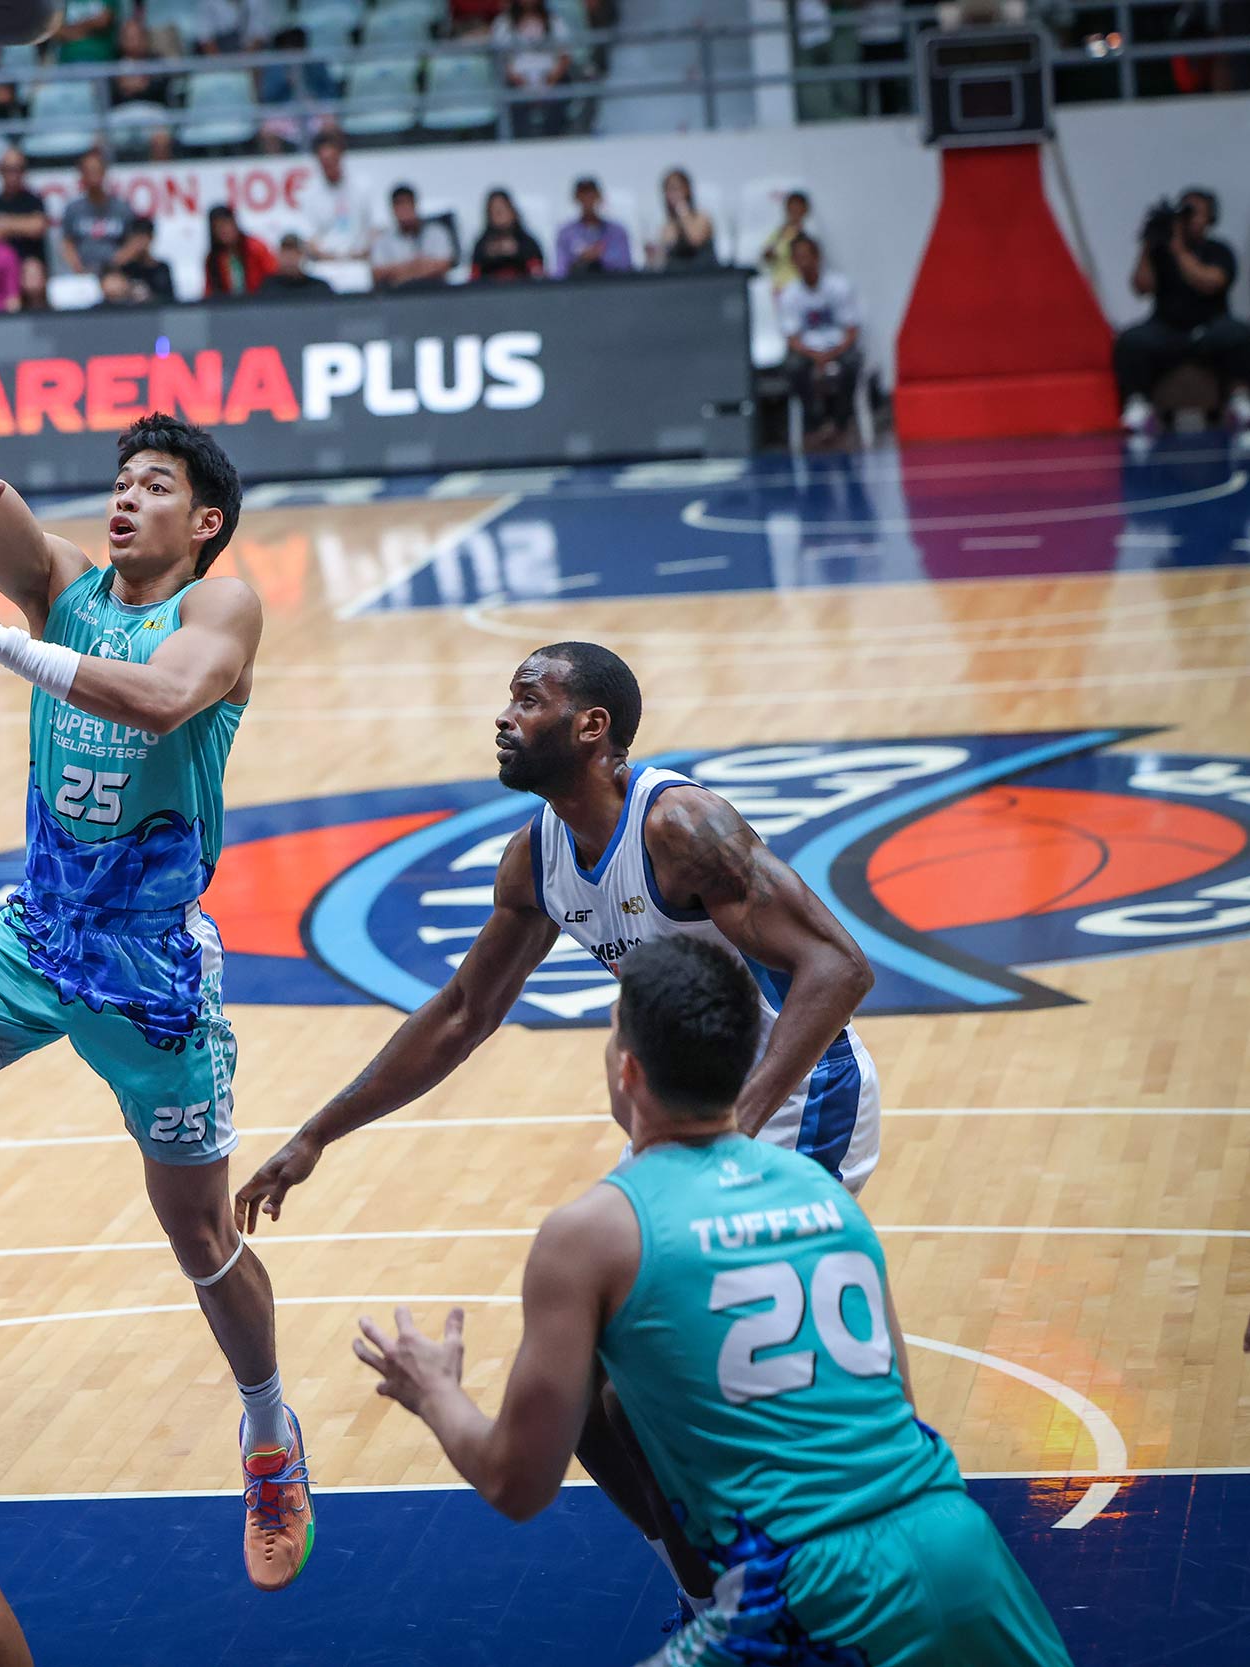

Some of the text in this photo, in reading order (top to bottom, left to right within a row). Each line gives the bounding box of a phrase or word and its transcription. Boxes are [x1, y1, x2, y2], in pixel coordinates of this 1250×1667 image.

[55, 764, 131, 825] 25
[150, 1099, 212, 1144] 25
[689, 1199, 845, 1254] TUFFIN
[708, 1250, 893, 1407] 20
